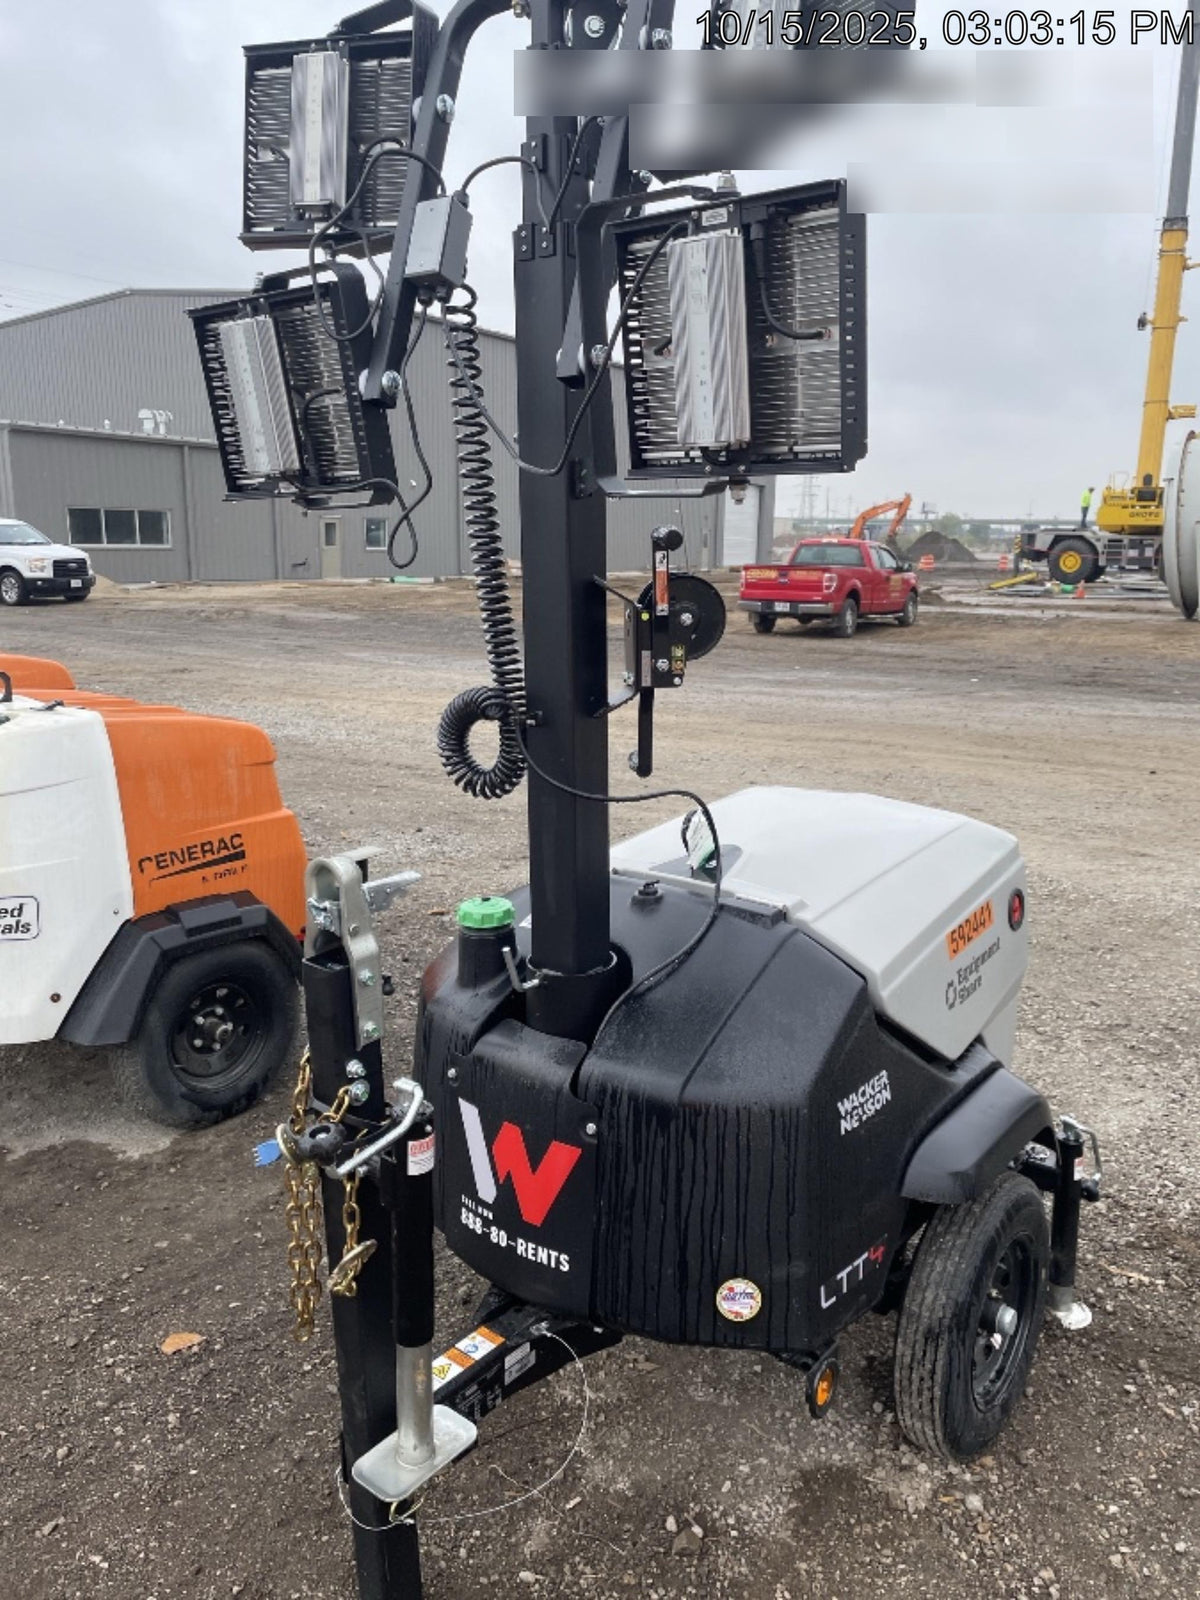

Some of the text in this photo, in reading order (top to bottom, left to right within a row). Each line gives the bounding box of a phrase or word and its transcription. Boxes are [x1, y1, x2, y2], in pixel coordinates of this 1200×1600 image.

[0, 919, 32, 935] als
[950, 900, 993, 954] 592441
[837, 1069, 889, 1117] WACKER
[460, 1206, 571, 1273] 888-80-RENTS
